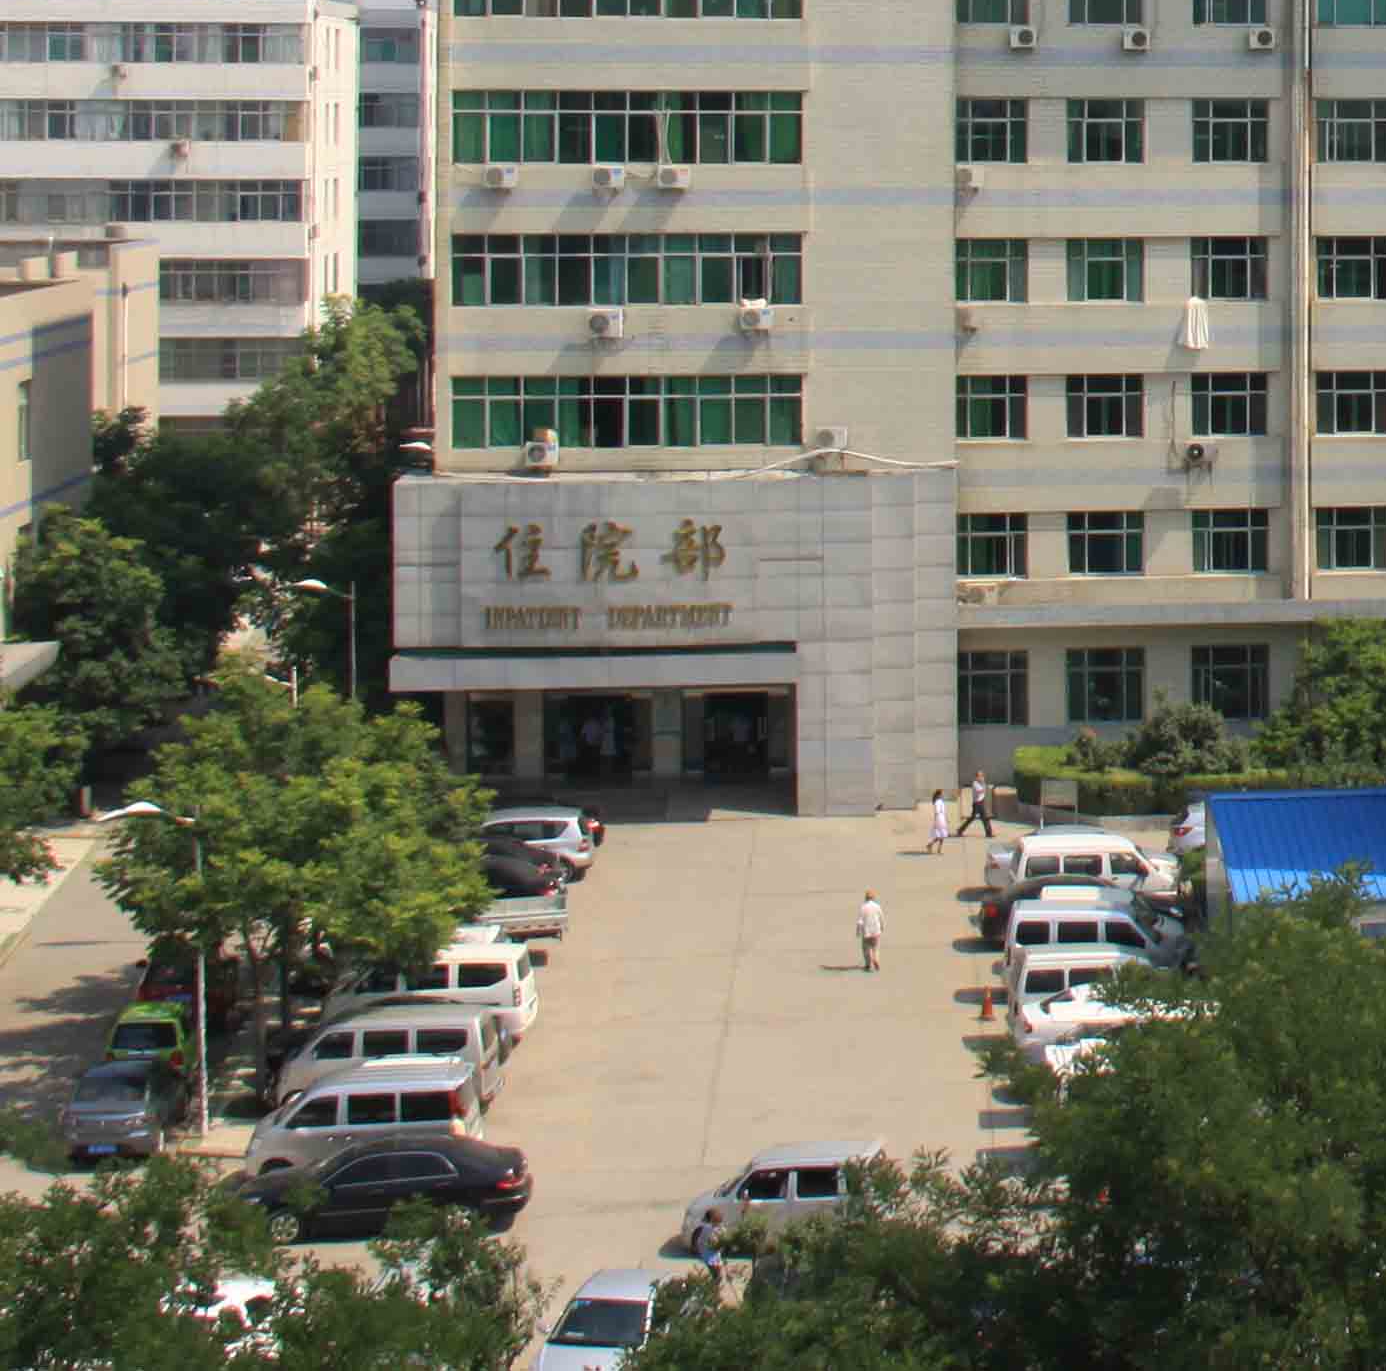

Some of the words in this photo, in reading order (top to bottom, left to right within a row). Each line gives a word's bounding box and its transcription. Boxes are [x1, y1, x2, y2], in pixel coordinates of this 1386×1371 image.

[493, 517, 727, 582] 住院部
[606, 602, 734, 629] DEPARTMENT
